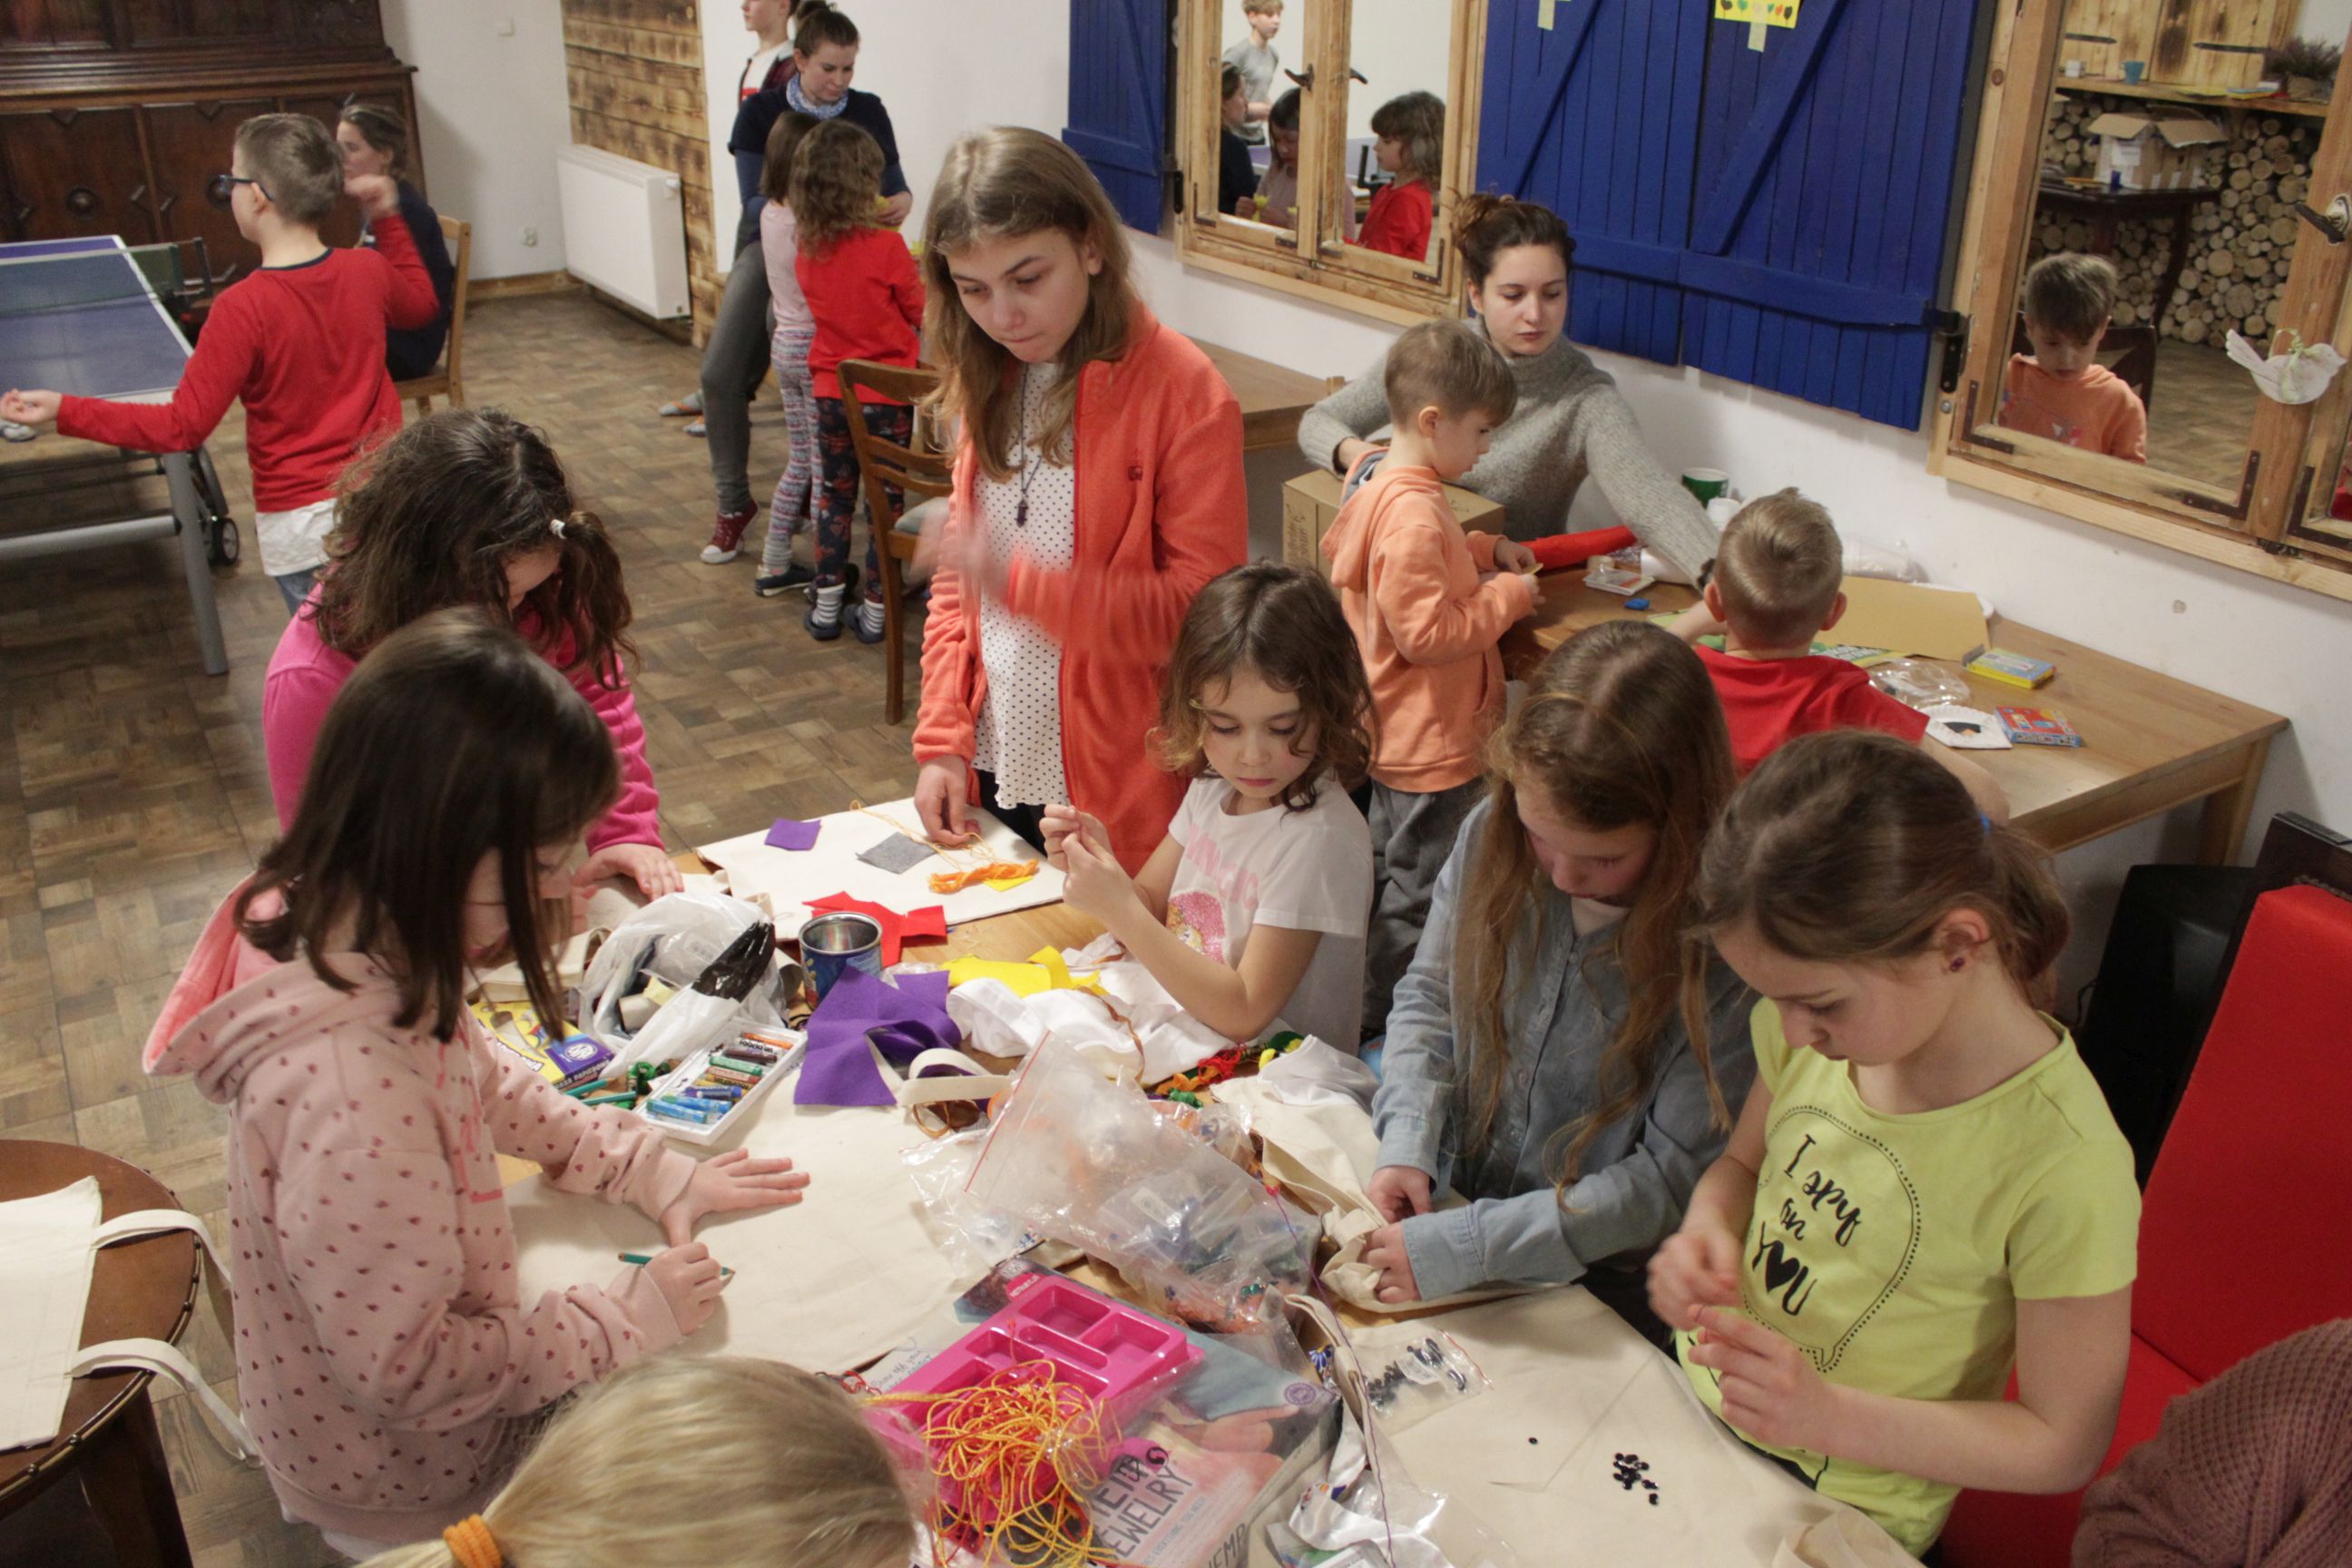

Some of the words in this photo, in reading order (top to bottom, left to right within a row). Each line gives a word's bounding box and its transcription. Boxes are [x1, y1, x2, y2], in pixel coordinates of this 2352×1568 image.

[1784, 1134, 1817, 1178] I
[1802, 1171, 1862, 1247] spy
[1100, 1464, 1193, 1559] EWELRY
